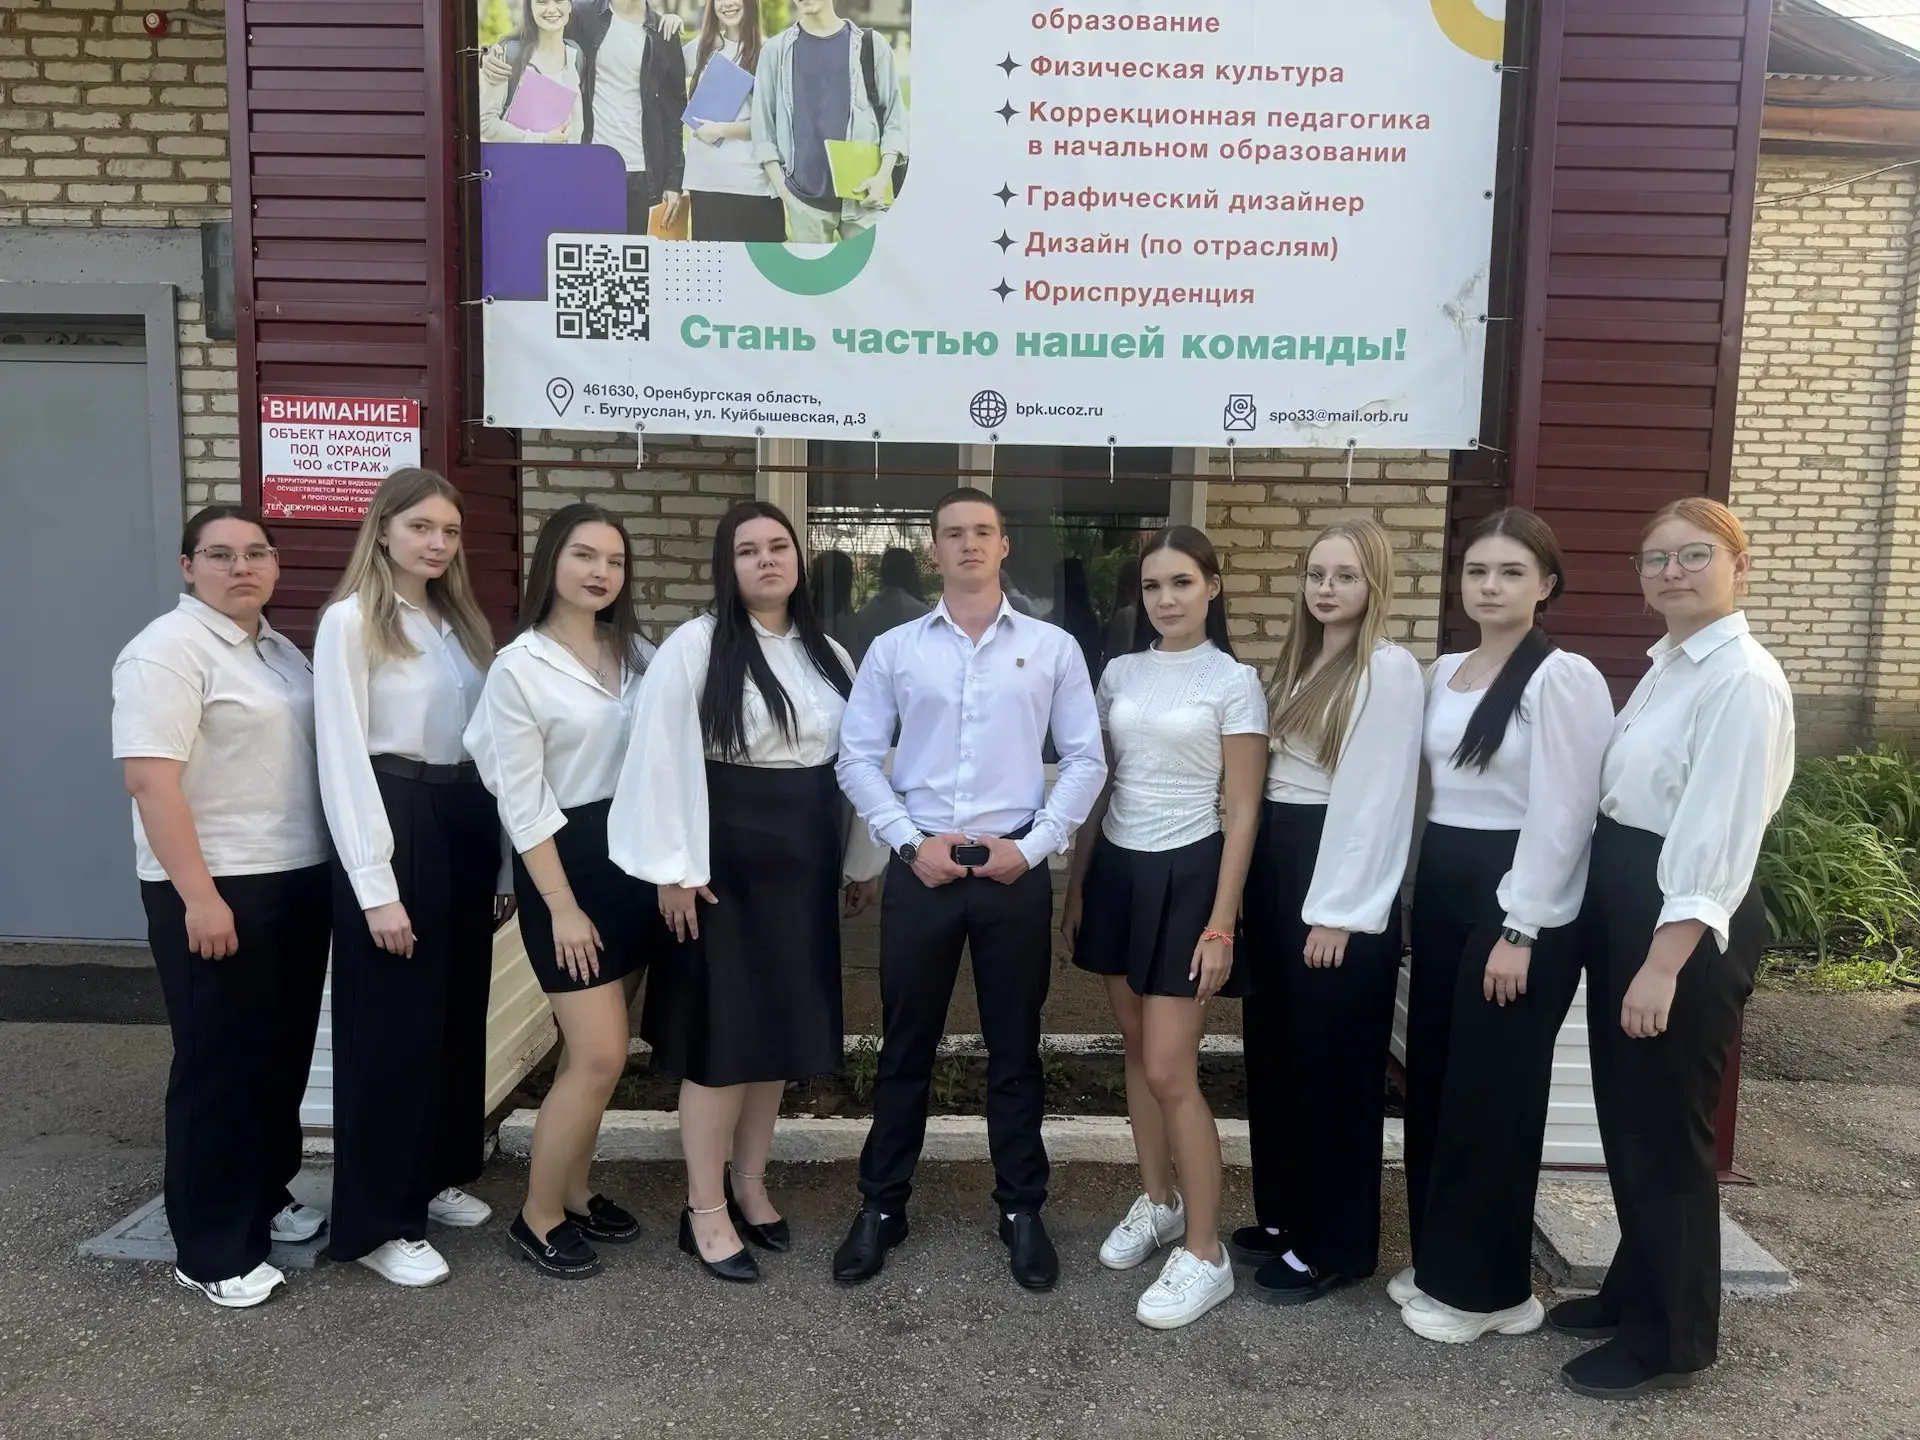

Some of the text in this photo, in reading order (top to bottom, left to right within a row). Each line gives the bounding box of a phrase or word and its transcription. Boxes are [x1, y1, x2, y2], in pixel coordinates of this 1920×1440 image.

[1031, 7, 1220, 35] образование
[1030, 55, 1345, 86] Физическая культура
[1029, 101, 1430, 132] Коррекционная педагогика
[1028, 138, 1406, 165] в начальном образовании
[1027, 185, 1364, 214] Графический дизайнер
[1025, 231, 1338, 261] Дизайн (по отраслям)
[1025, 279, 1255, 308] Юриспруденция
[680, 314, 1407, 367] Стань частью нашей команды!
[582, 384, 822, 406] 461630, Оренбургская область,
[269, 400, 408, 423] ВНИМАНИЕ!
[584, 402, 867, 426] г. Бугуруслан, ул. Куйбышевская, д.3
[1016, 402, 1103, 418] bpk.ucoz.ru
[1269, 408, 1409, 425] spo33@mail.orb.ru
[269, 428, 412, 444] ОБЪЕКТ НАХОДИТСЯ
[290, 444, 391, 458] ПОД ОХРАНОЙ
[293, 459, 389, 473] ЧОО «СТРАЖ»
